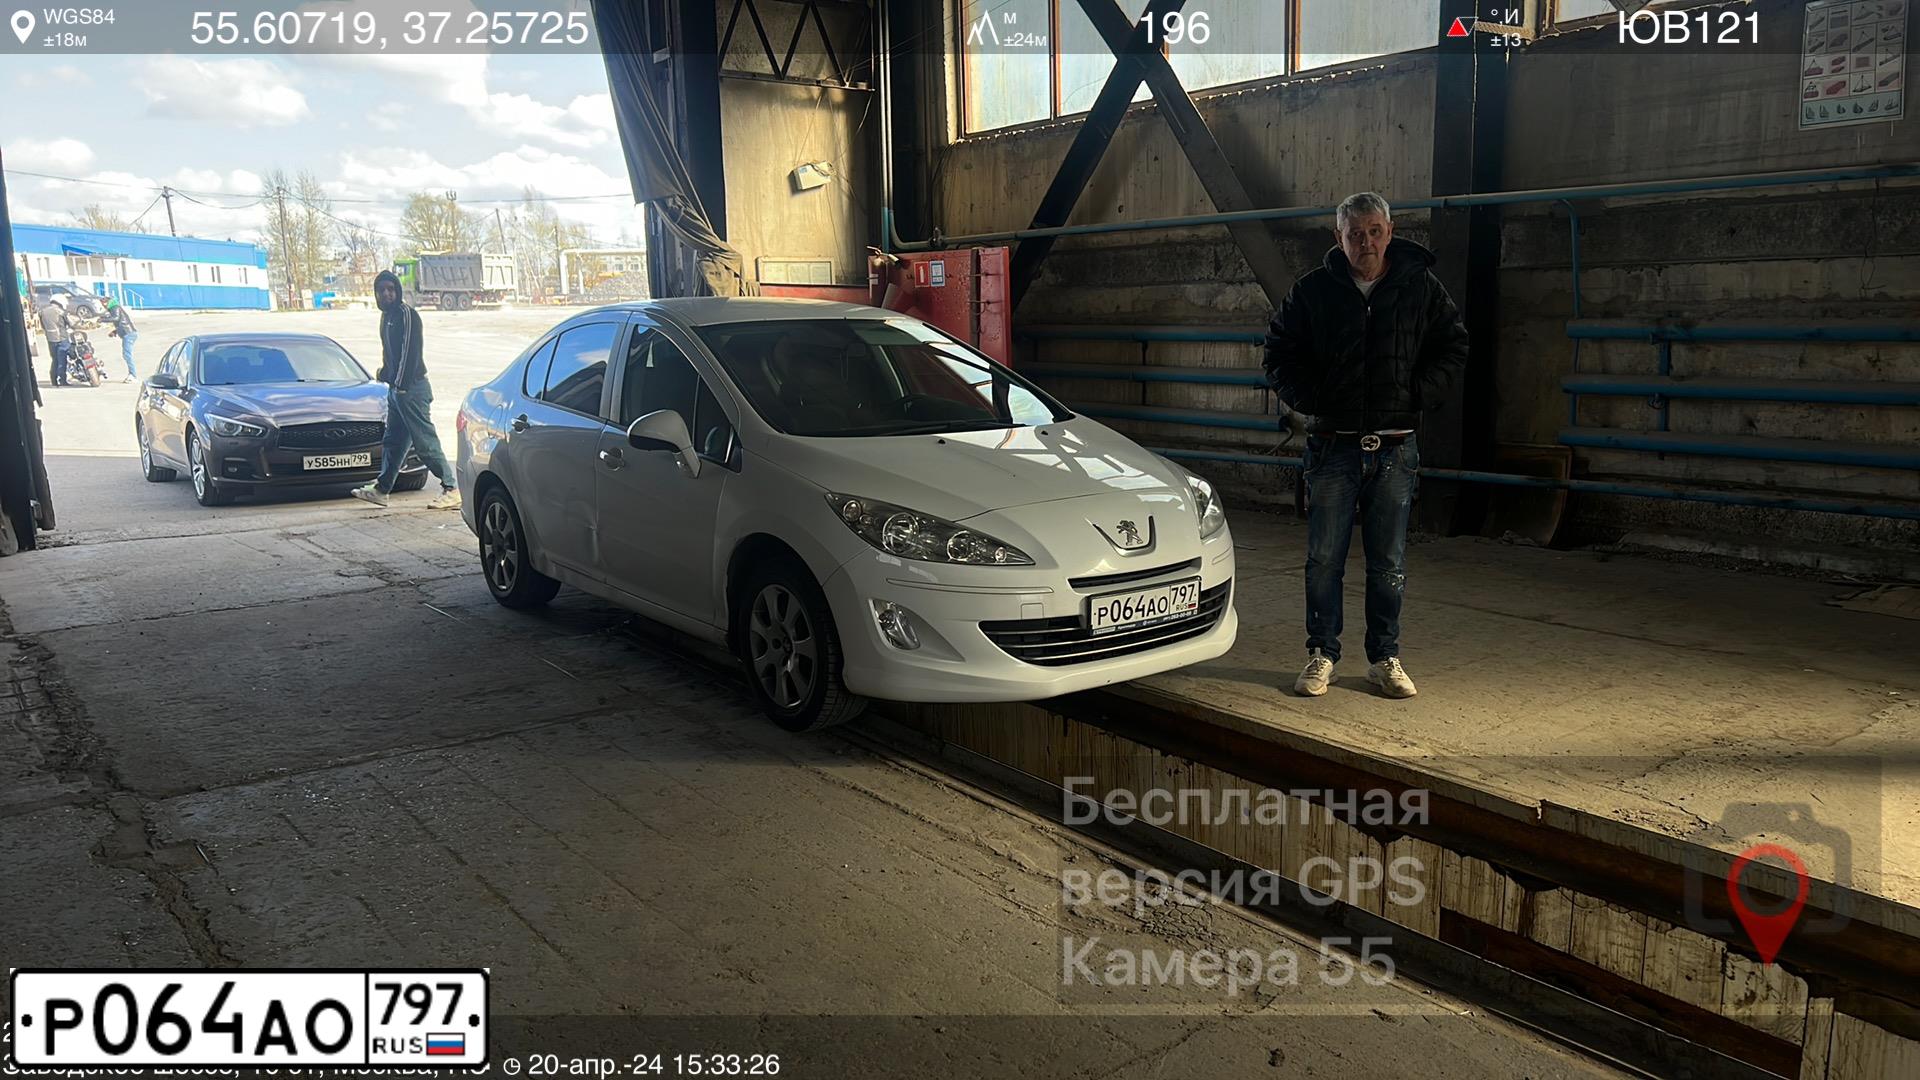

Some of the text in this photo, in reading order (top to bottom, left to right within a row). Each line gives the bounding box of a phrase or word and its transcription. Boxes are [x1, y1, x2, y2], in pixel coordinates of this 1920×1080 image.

[307, 454, 368, 468] У585НН 799
[1098, 584, 1195, 625] Р064АО 797
[1176, 603, 1188, 611] RUS
